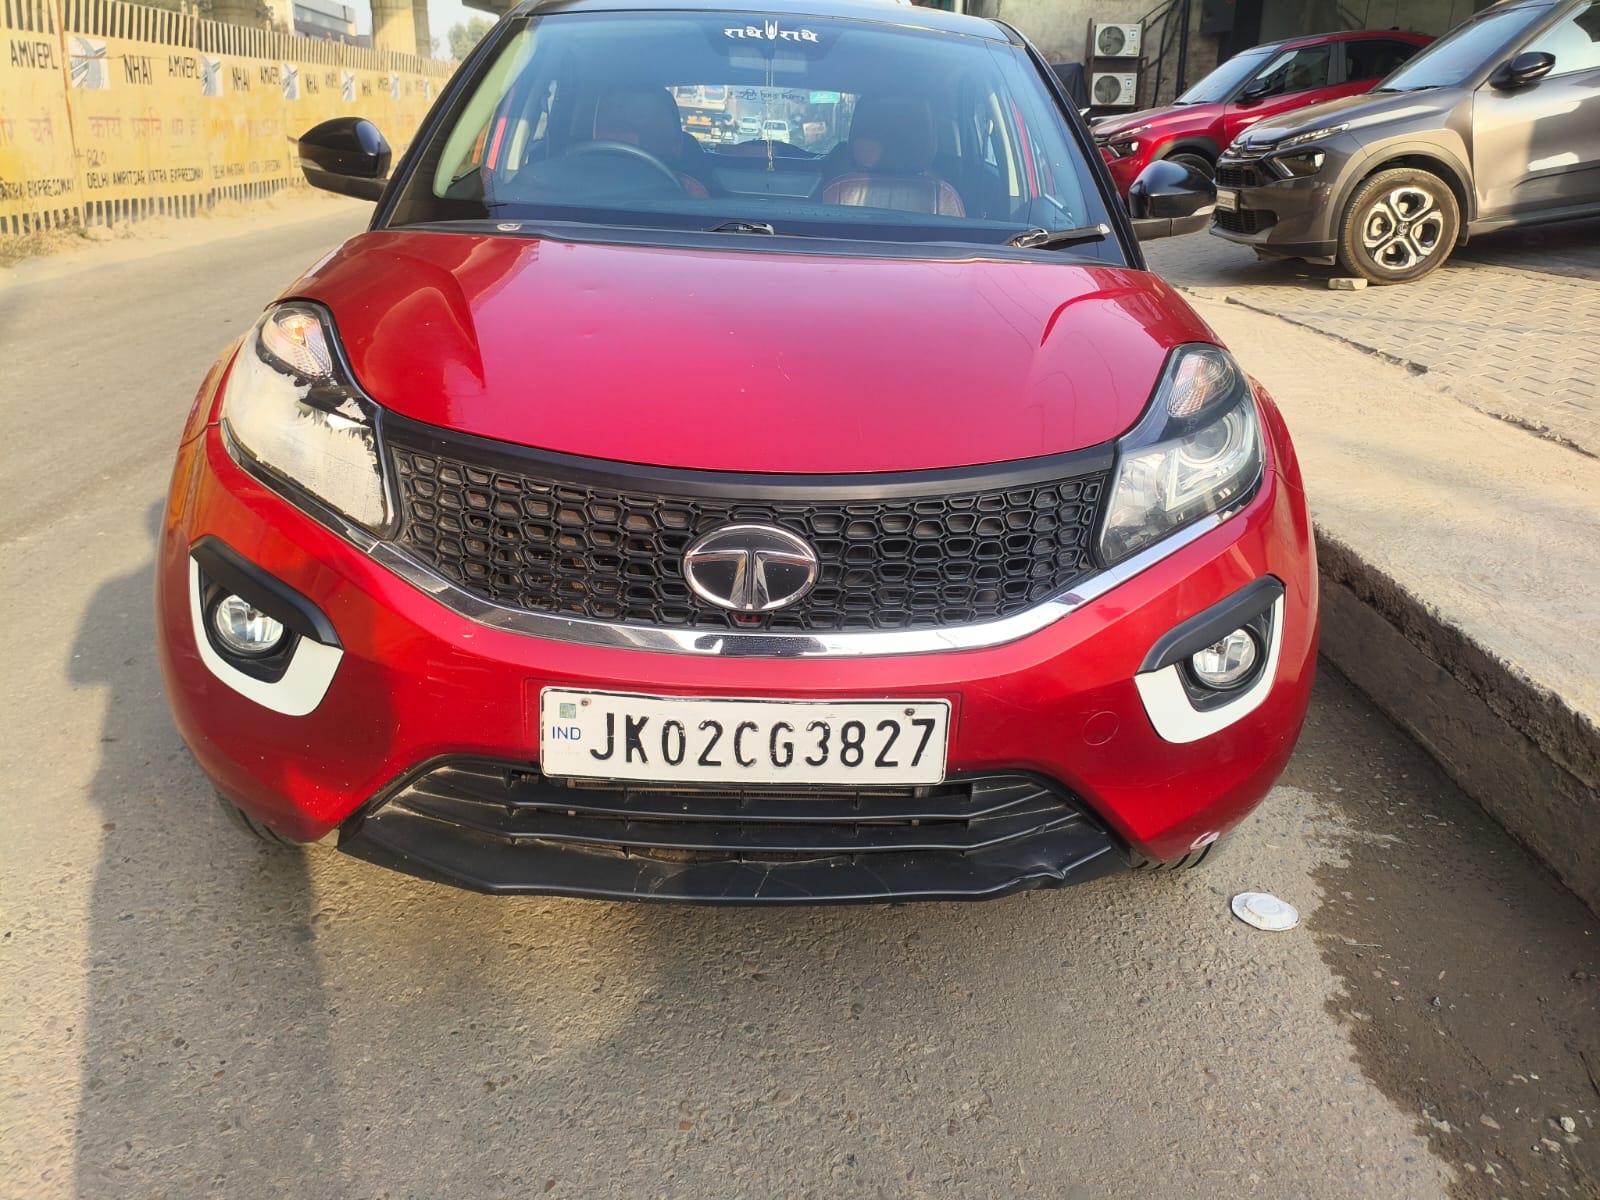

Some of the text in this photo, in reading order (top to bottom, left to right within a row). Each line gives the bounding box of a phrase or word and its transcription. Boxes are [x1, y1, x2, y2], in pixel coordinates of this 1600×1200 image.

[724, 26, 819, 43] राधे राधे
[9, 39, 59, 70] AMVEPL
[123, 53, 153, 85] NHAI
[551, 725, 582, 742] IND
[589, 711, 937, 768] JK02CG3827
